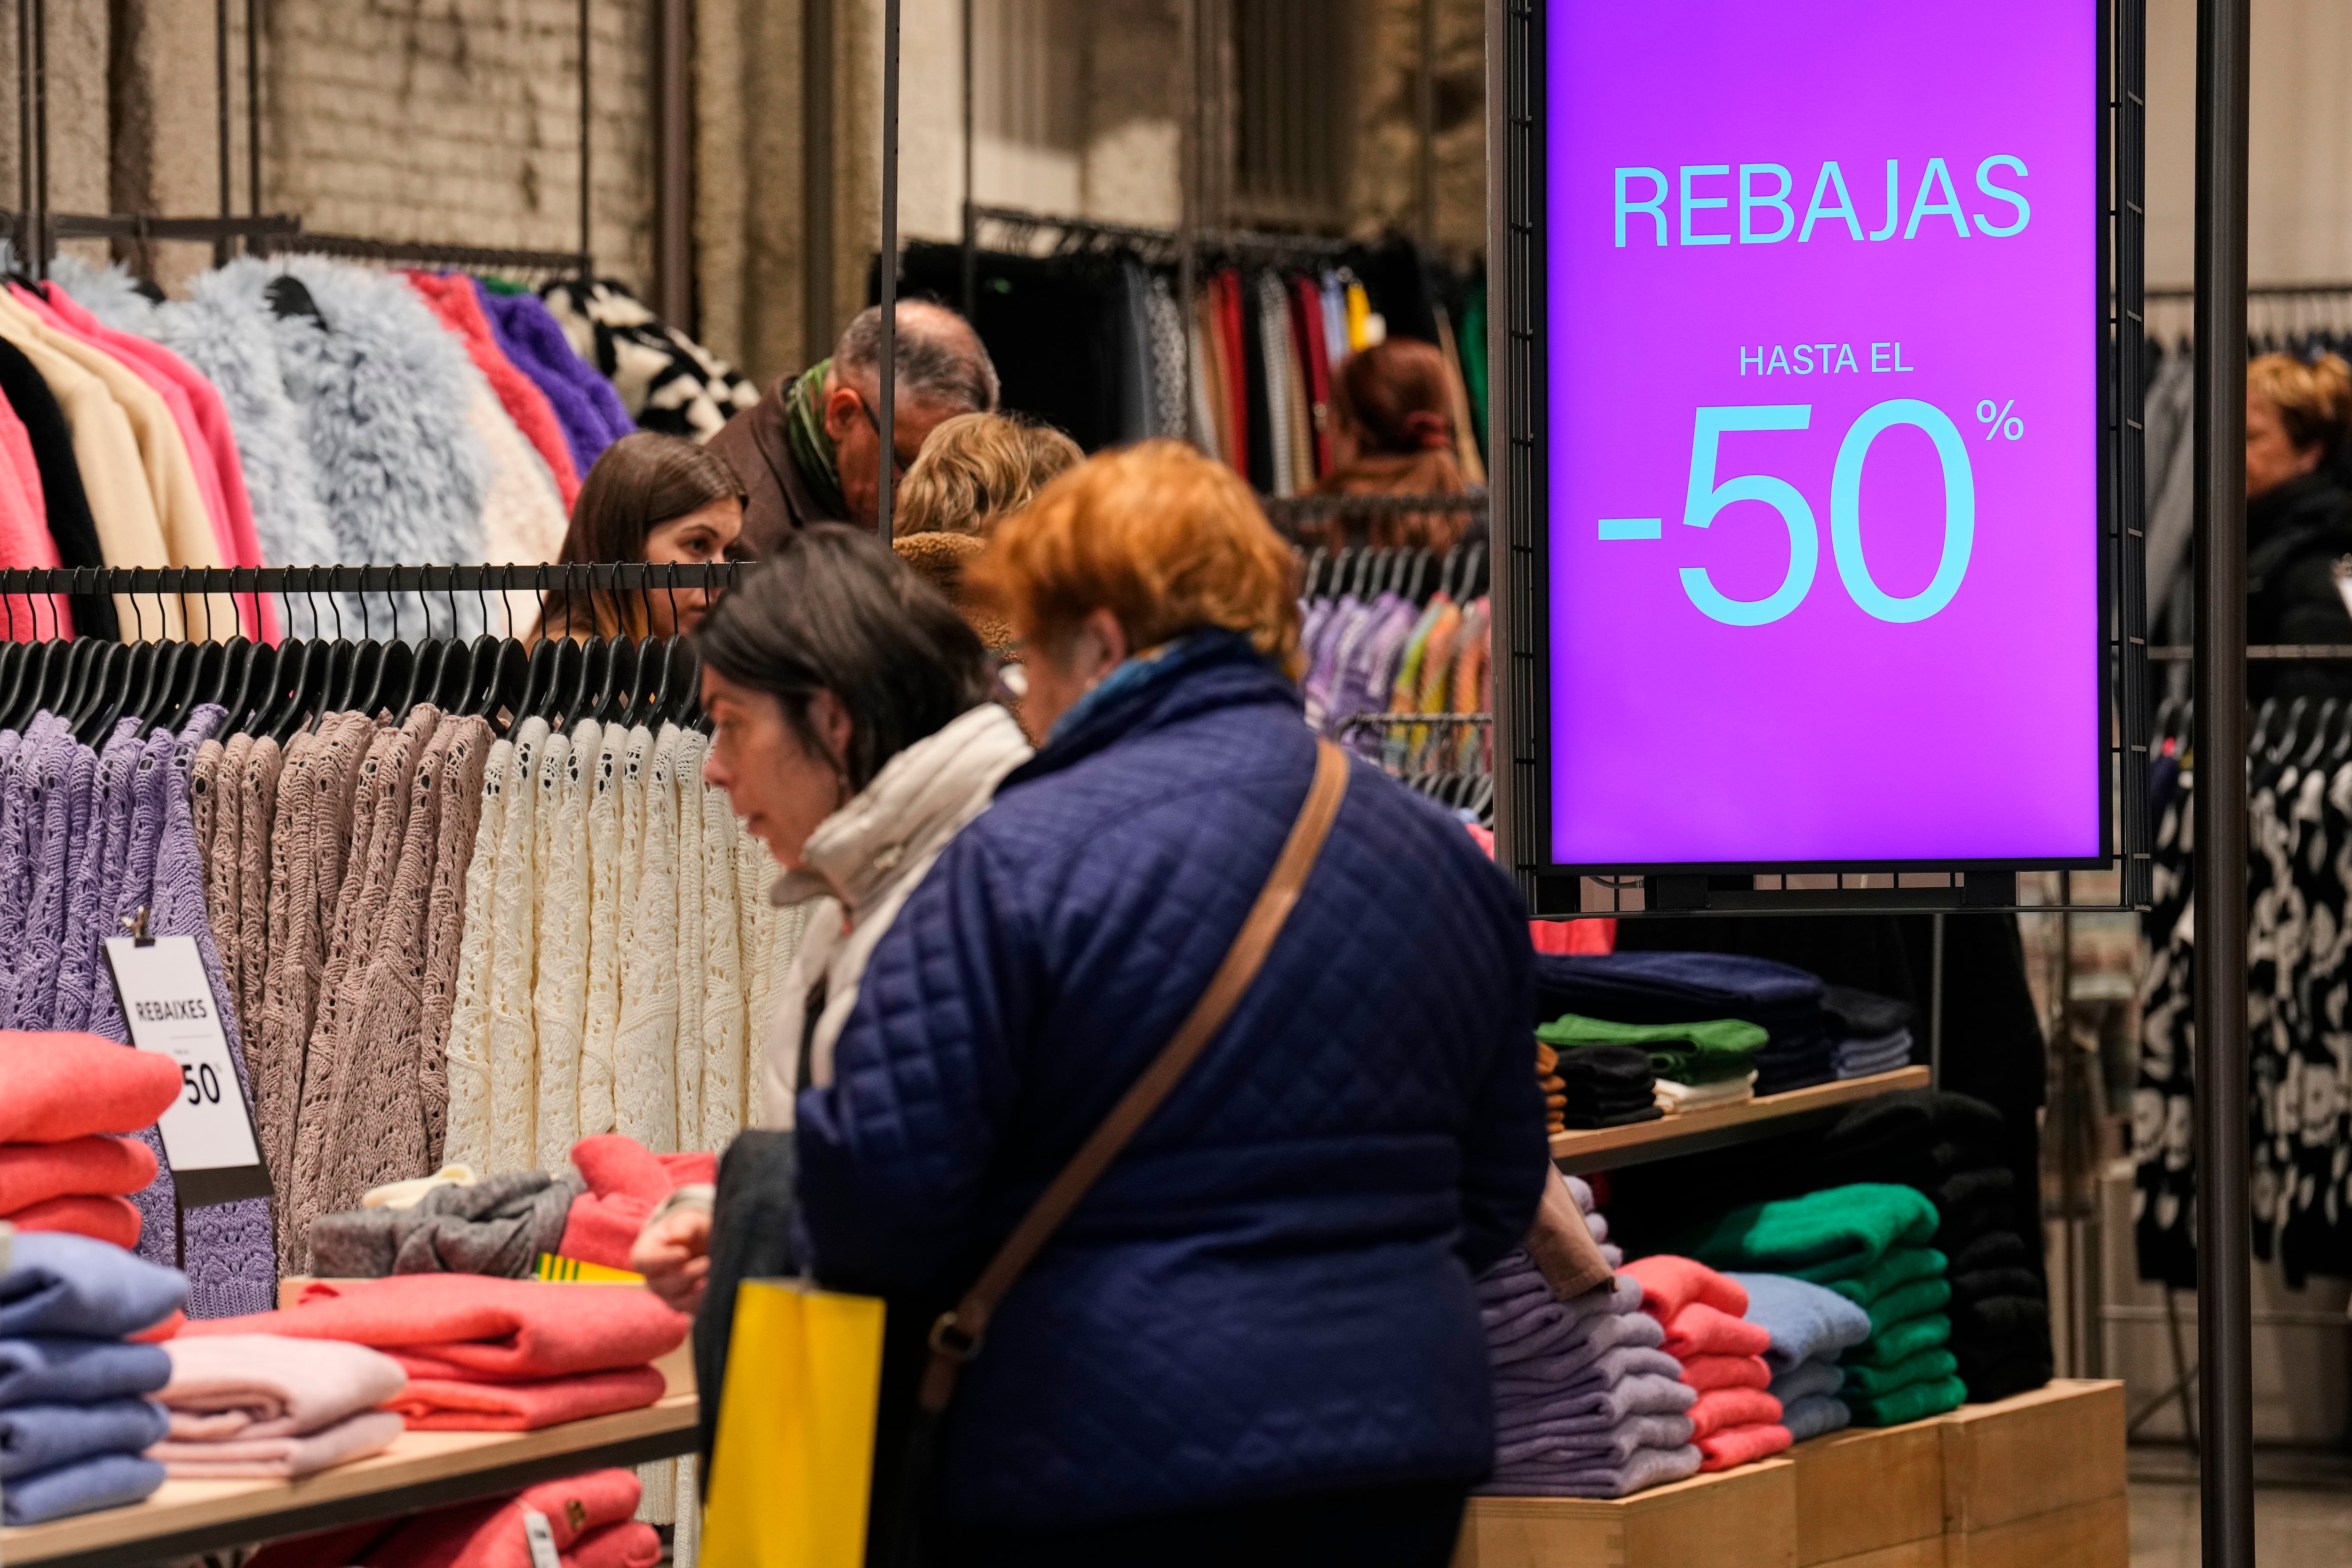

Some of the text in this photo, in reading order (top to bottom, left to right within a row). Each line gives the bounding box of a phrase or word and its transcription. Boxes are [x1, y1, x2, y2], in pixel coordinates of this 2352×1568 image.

[1615, 155, 2030, 247] REBAJAS
[1741, 342, 1913, 375] HASTA EL
[135, 999, 207, 1021] REBAIXES
